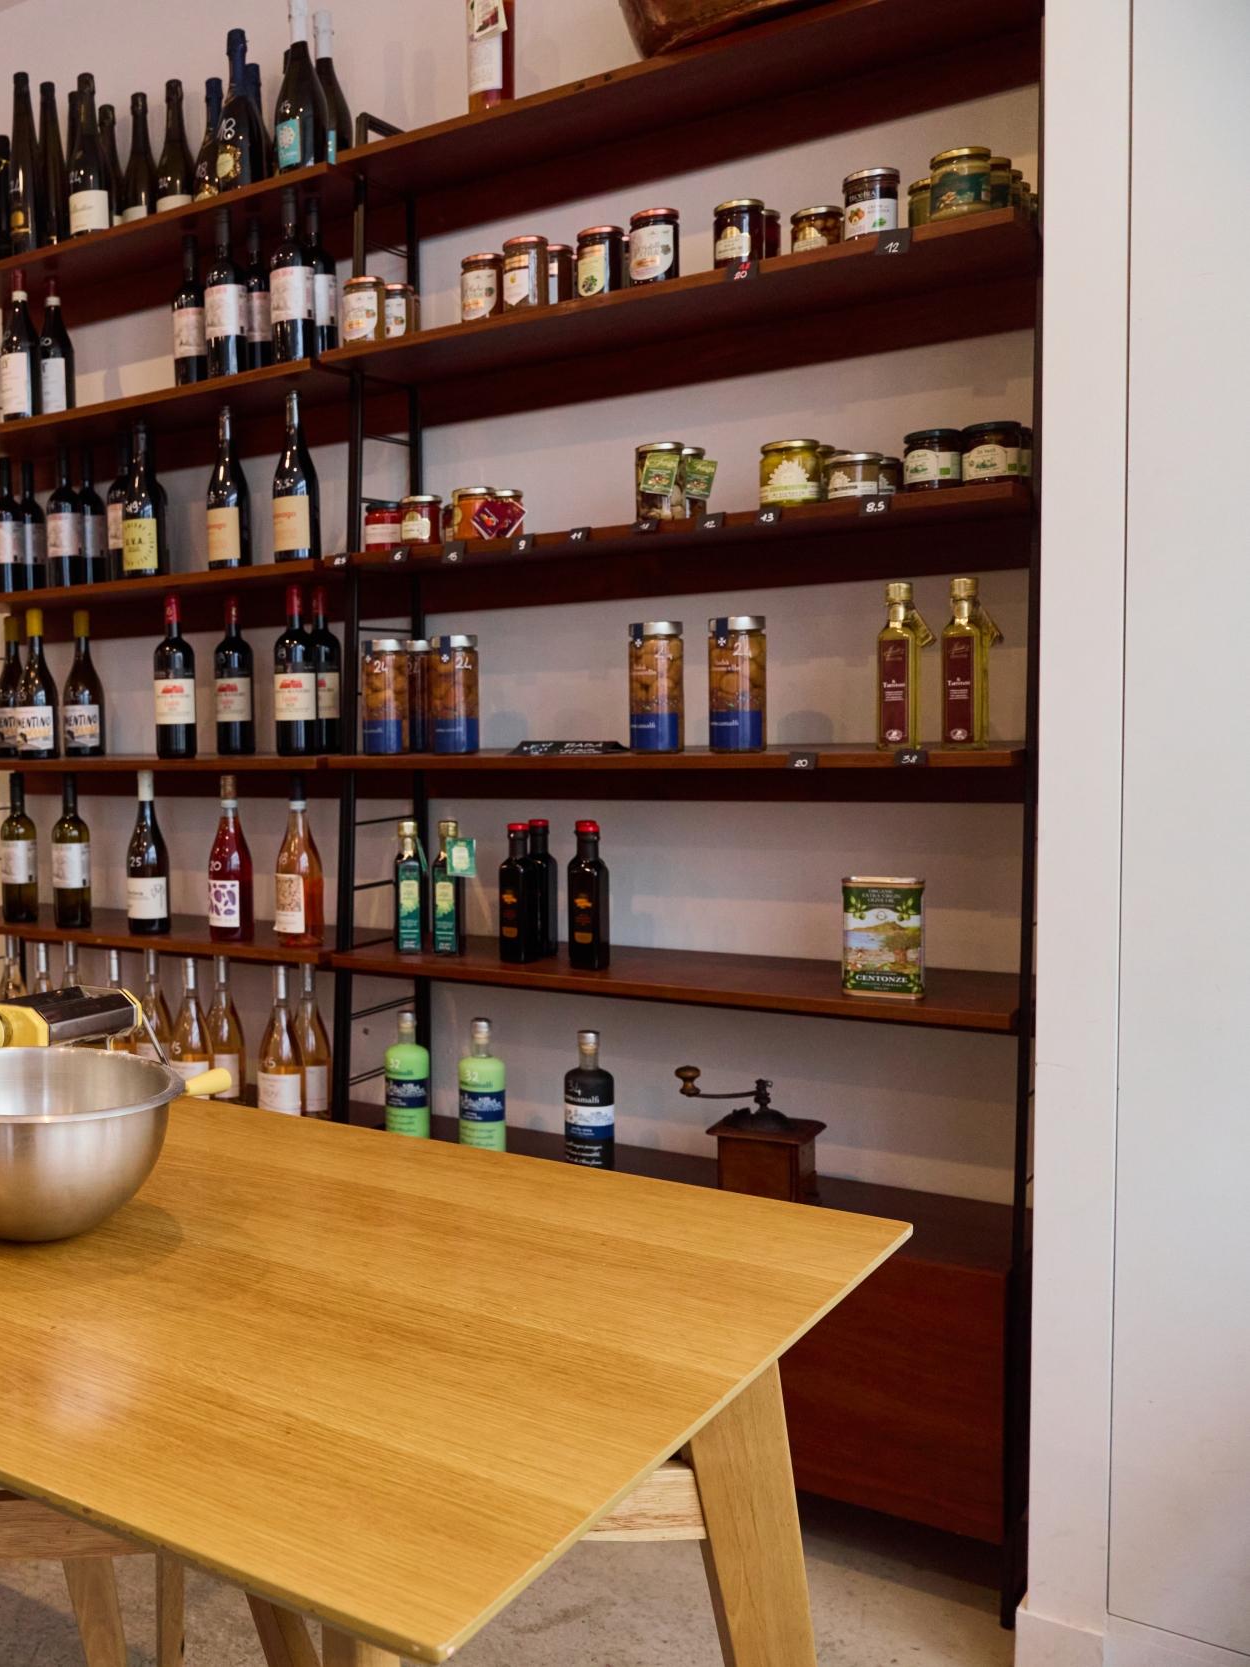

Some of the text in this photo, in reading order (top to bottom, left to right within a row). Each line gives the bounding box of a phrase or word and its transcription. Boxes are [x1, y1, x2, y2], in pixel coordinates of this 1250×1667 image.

[217, 117, 236, 140] 18
[885, 242, 899, 253] 12
[866, 501, 885, 512] 8,5
[760, 512, 774, 522] 13
[518, 540, 526, 550] 9
[393, 551, 402, 561] 6
[373, 660, 389, 674] 24
[455, 656, 472, 670] 24
[130, 856, 142, 868] 25
[855, 974, 909, 984] CENTONZE
[465, 1071, 479, 1083] 32
